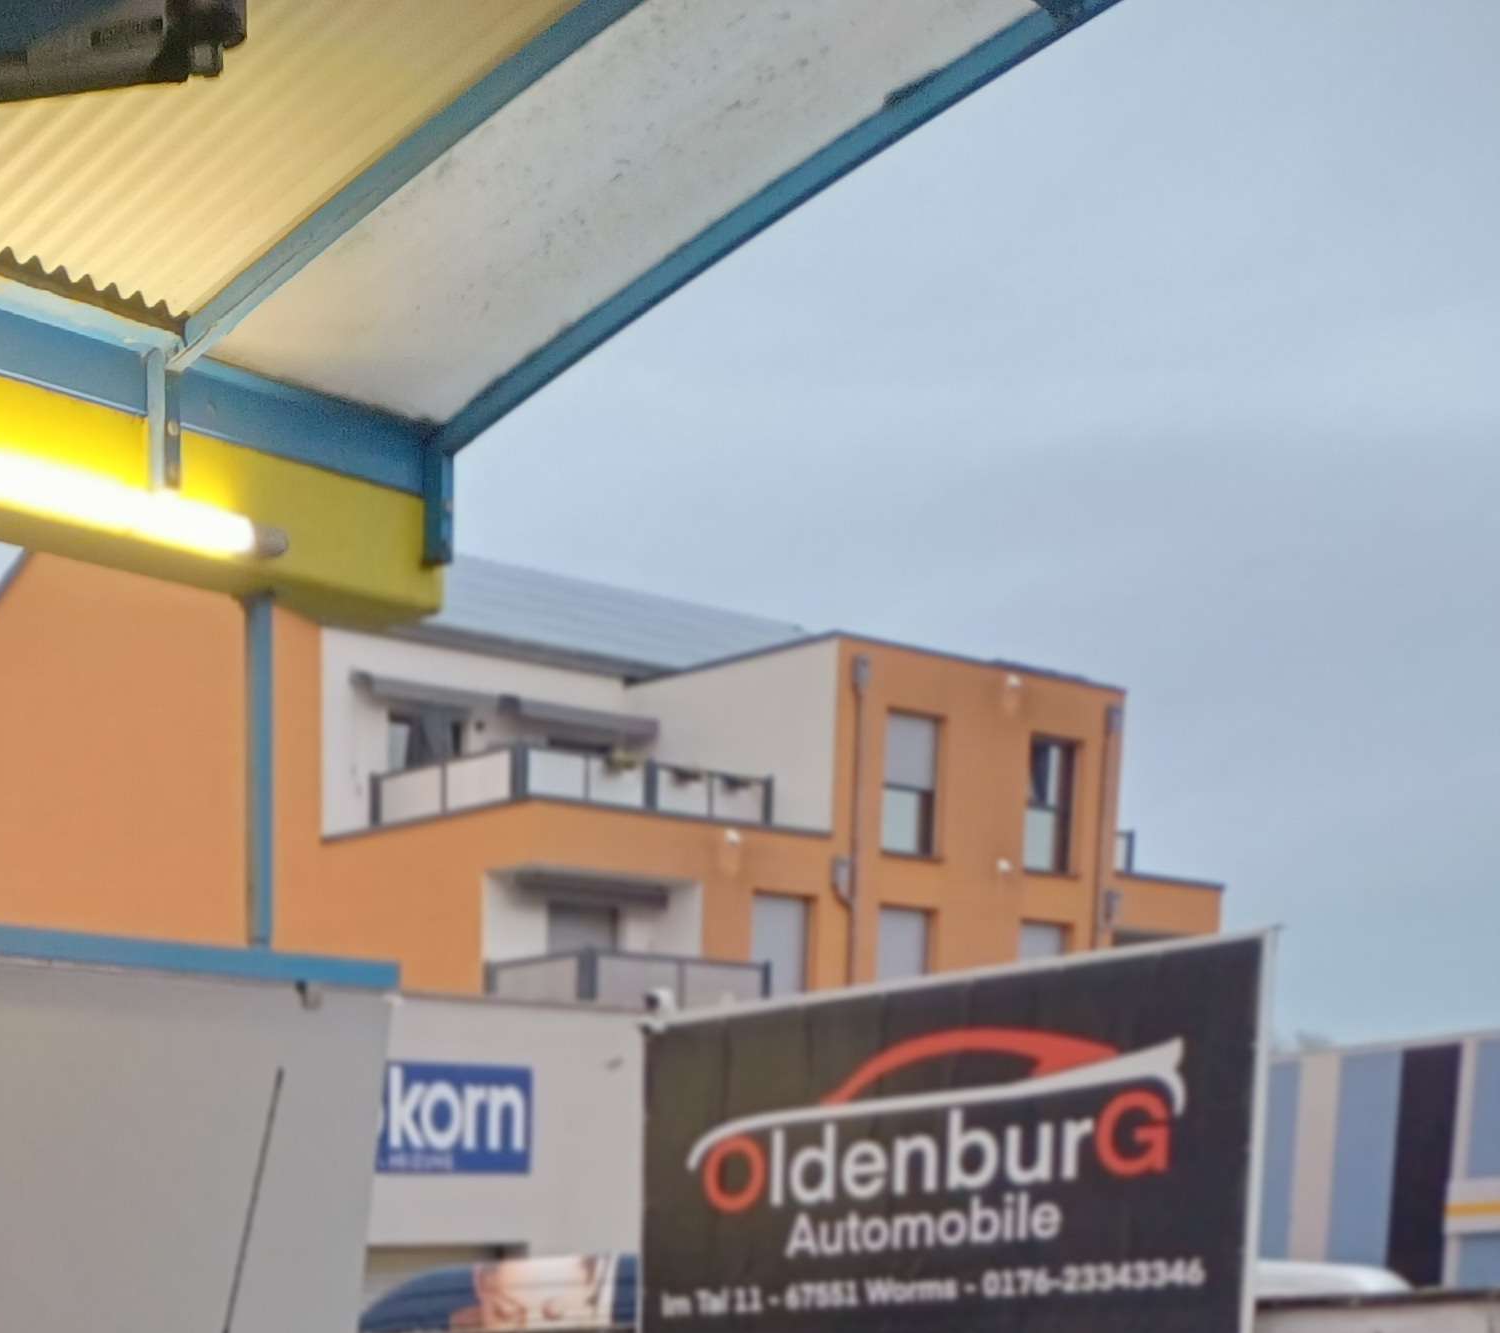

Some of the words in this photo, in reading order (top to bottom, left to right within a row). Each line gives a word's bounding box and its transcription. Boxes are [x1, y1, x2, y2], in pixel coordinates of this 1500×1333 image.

[379, 1065, 525, 1152] korn
[703, 1088, 1171, 1212] OldenburG
[785, 1192, 1061, 1258] Automobile
[661, 1290, 692, 1317] Im
[734, 1285, 762, 1313] 11
[864, 1276, 958, 1305] Worms
